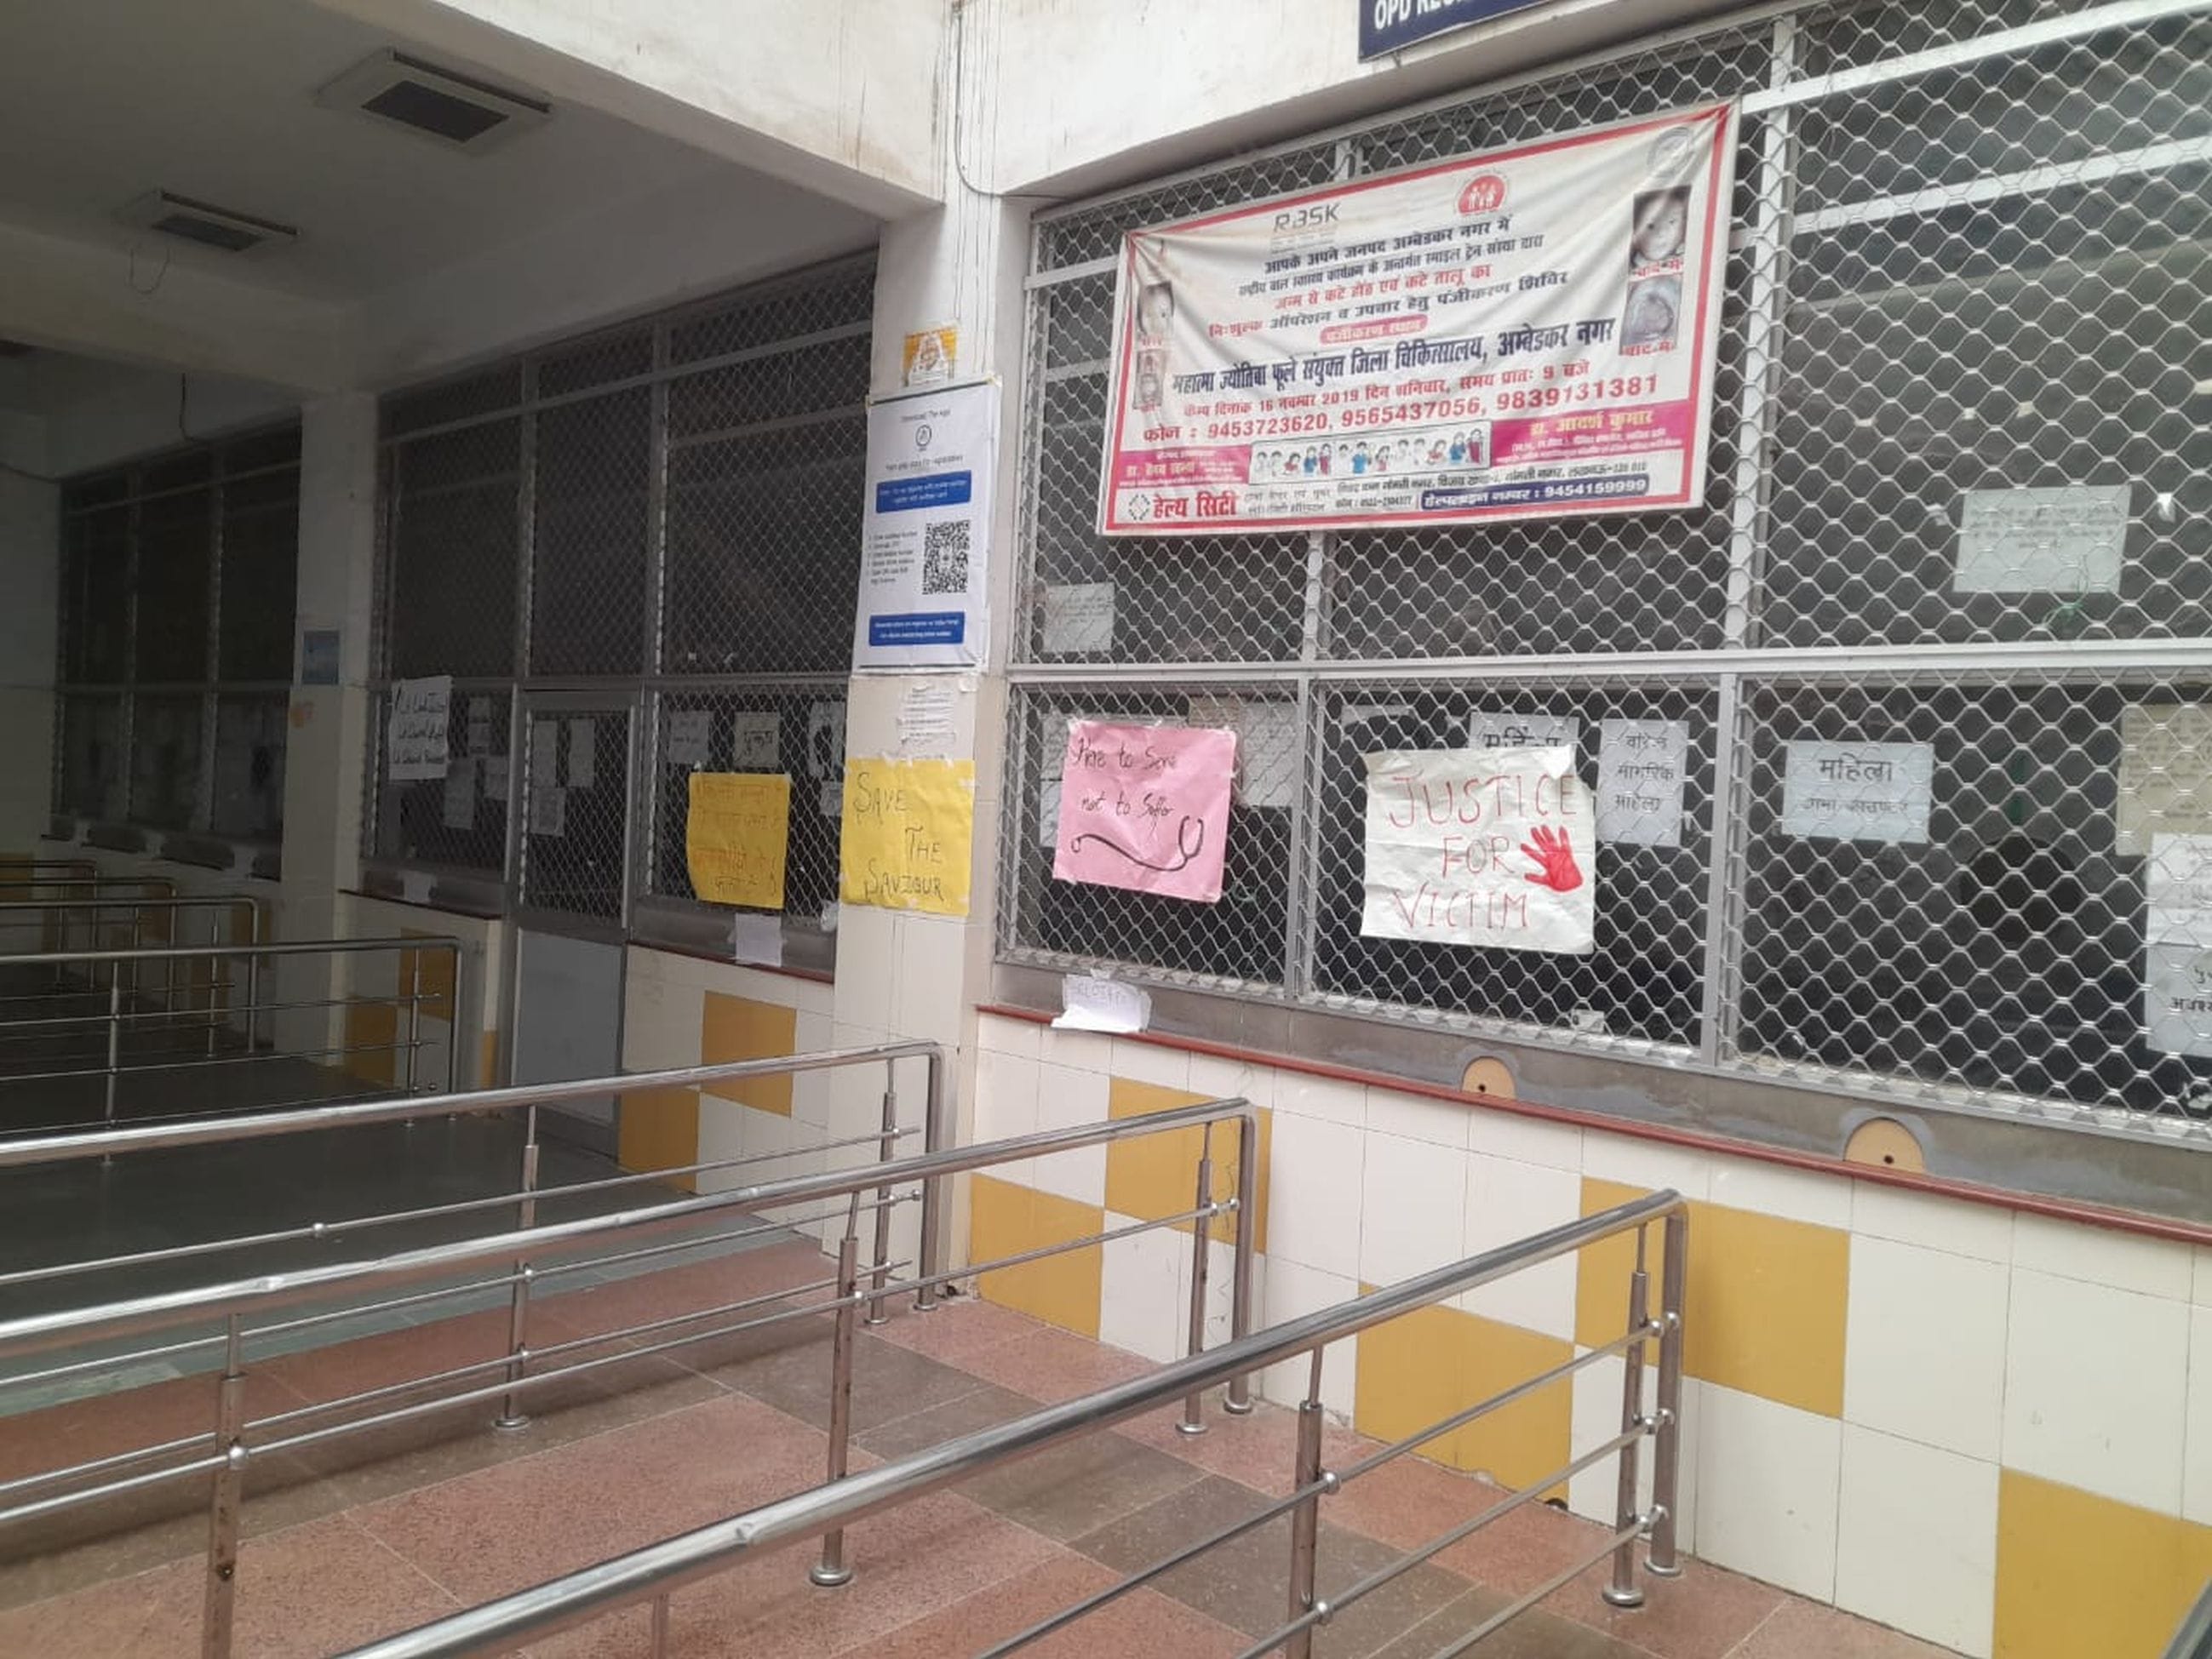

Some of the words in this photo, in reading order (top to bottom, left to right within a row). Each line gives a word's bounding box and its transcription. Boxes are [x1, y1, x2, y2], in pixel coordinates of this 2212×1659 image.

[1374, 0, 1412, 30] OPD
[1308, 246, 1338, 266] अपने
[1344, 239, 1386, 259] जनपद
[1394, 228, 1454, 250] अम्बेडकर
[1460, 221, 1491, 237] नगर
[1497, 214, 1513, 232] में
[1471, 263, 1492, 279] का
[1172, 371, 1215, 394] महात्मा
[1303, 351, 1345, 386] संयुक्त
[1350, 346, 1390, 375] जिला
[1498, 323, 1570, 357] अम्बेडकर
[1575, 317, 1617, 342] नगर
[1143, 423, 1179, 443] फोन
[1496, 374, 1659, 412] 9839131381
[1259, 398, 1274, 412] 16
[1321, 388, 1359, 405] 2019
[1366, 384, 1390, 400] दिन
[1543, 365, 1556, 380] 9
[1196, 489, 1238, 517] सिटी
[1818, 752, 1894, 782] महिला
[1115, 790, 1132, 815] to
[1389, 773, 1577, 828] JUSTICE
[905, 826, 943, 864] THE
[1441, 835, 1516, 878] FOR
[1392, 880, 1529, 930] VICTIM
